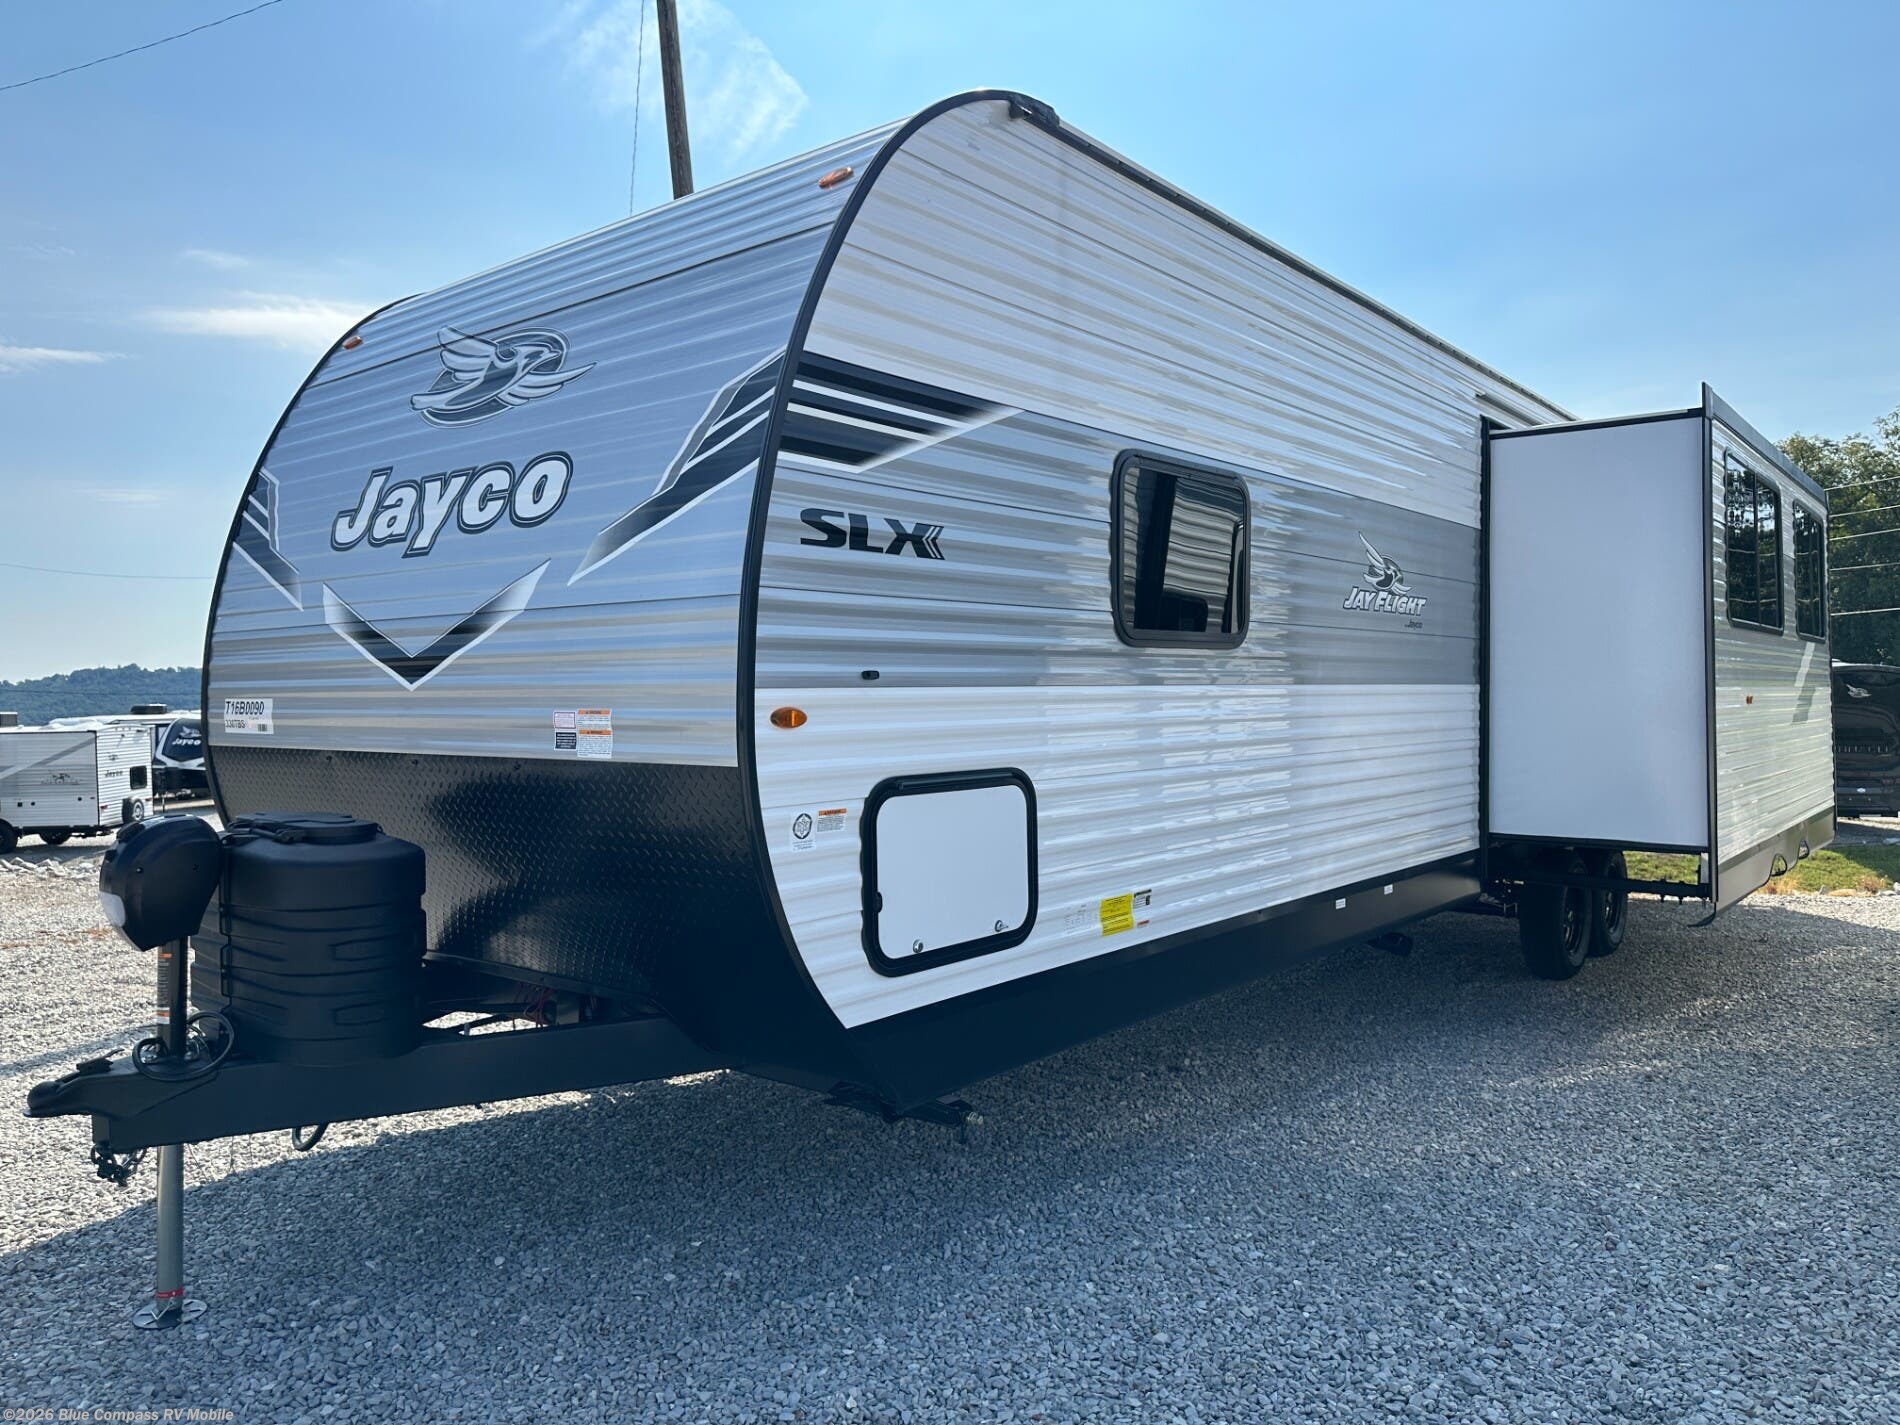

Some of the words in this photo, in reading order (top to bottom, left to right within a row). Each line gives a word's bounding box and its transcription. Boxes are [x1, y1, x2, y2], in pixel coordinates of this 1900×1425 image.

[330, 450, 574, 559] Jayco
[800, 508, 945, 560] SLX
[1343, 586, 1376, 611] JAY
[1374, 590, 1428, 617] FLIGHT
[225, 701, 265, 715] T16B0090
[171, 737, 202, 746] Jayco
